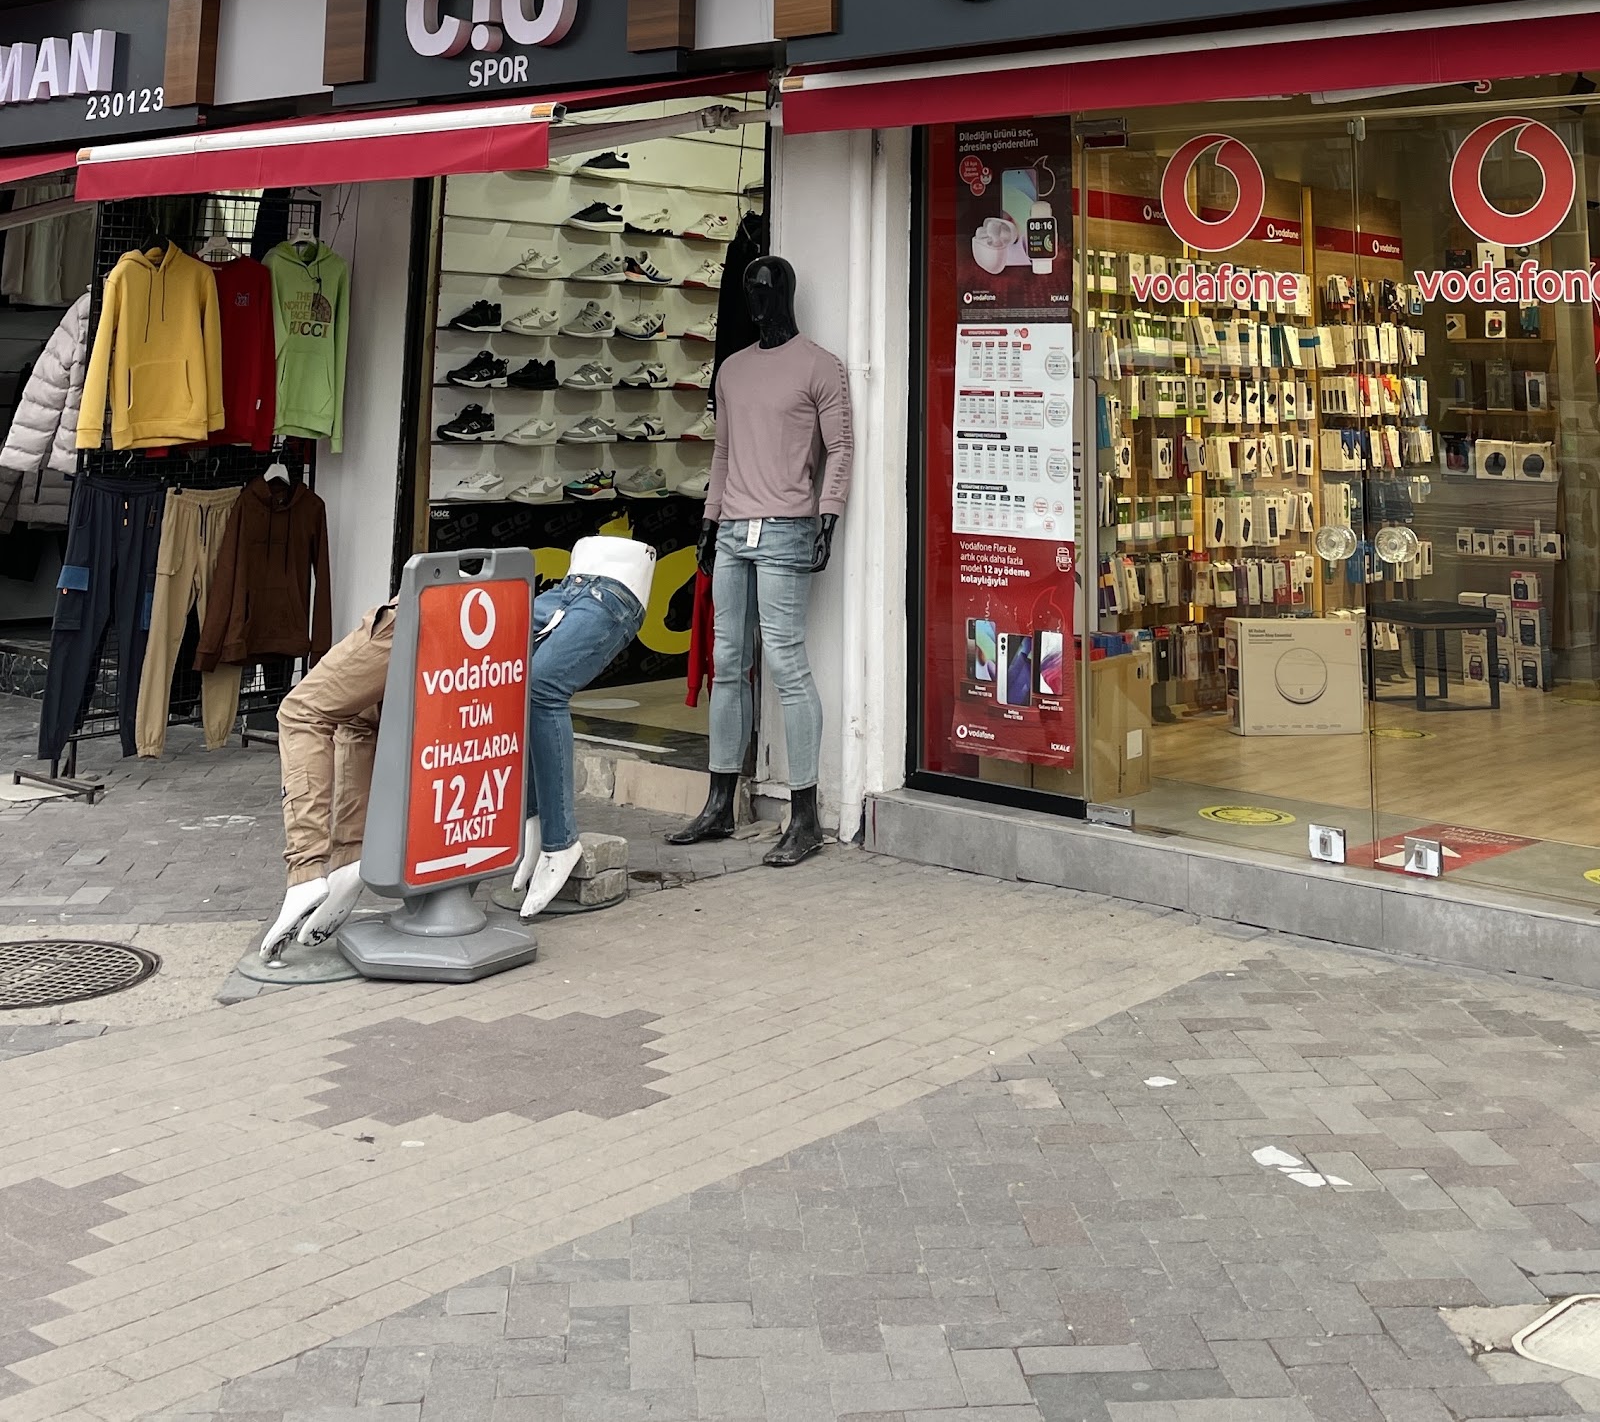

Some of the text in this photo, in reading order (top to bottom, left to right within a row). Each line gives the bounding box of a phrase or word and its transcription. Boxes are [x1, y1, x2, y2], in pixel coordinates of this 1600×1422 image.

[468, 54, 528, 88] SPOR
[85, 86, 164, 121] 230123
[959, 138, 1039, 152] adresine gönderelim!
[1275, 228, 1299, 240] vodafone
[1131, 262, 1299, 303] vodafone
[296, 291, 312, 301] THE
[284, 301, 310, 310] NORTH
[291, 311, 310, 320] FACE
[960, 541, 1016, 553] Vodafone Flex ile
[990, 554, 1006, 564] daha
[1007, 555, 1023, 565] fazla
[960, 564, 1030, 577] model 12 ay ödeme
[422, 656, 523, 696] vodafone
[459, 699, 492, 729] TÜM
[968, 729, 995, 740] vodafone
[421, 733, 519, 771] CİHAZLARDA
[432, 766, 512, 824] 12 AY
[443, 809, 497, 846] TAKSİT
